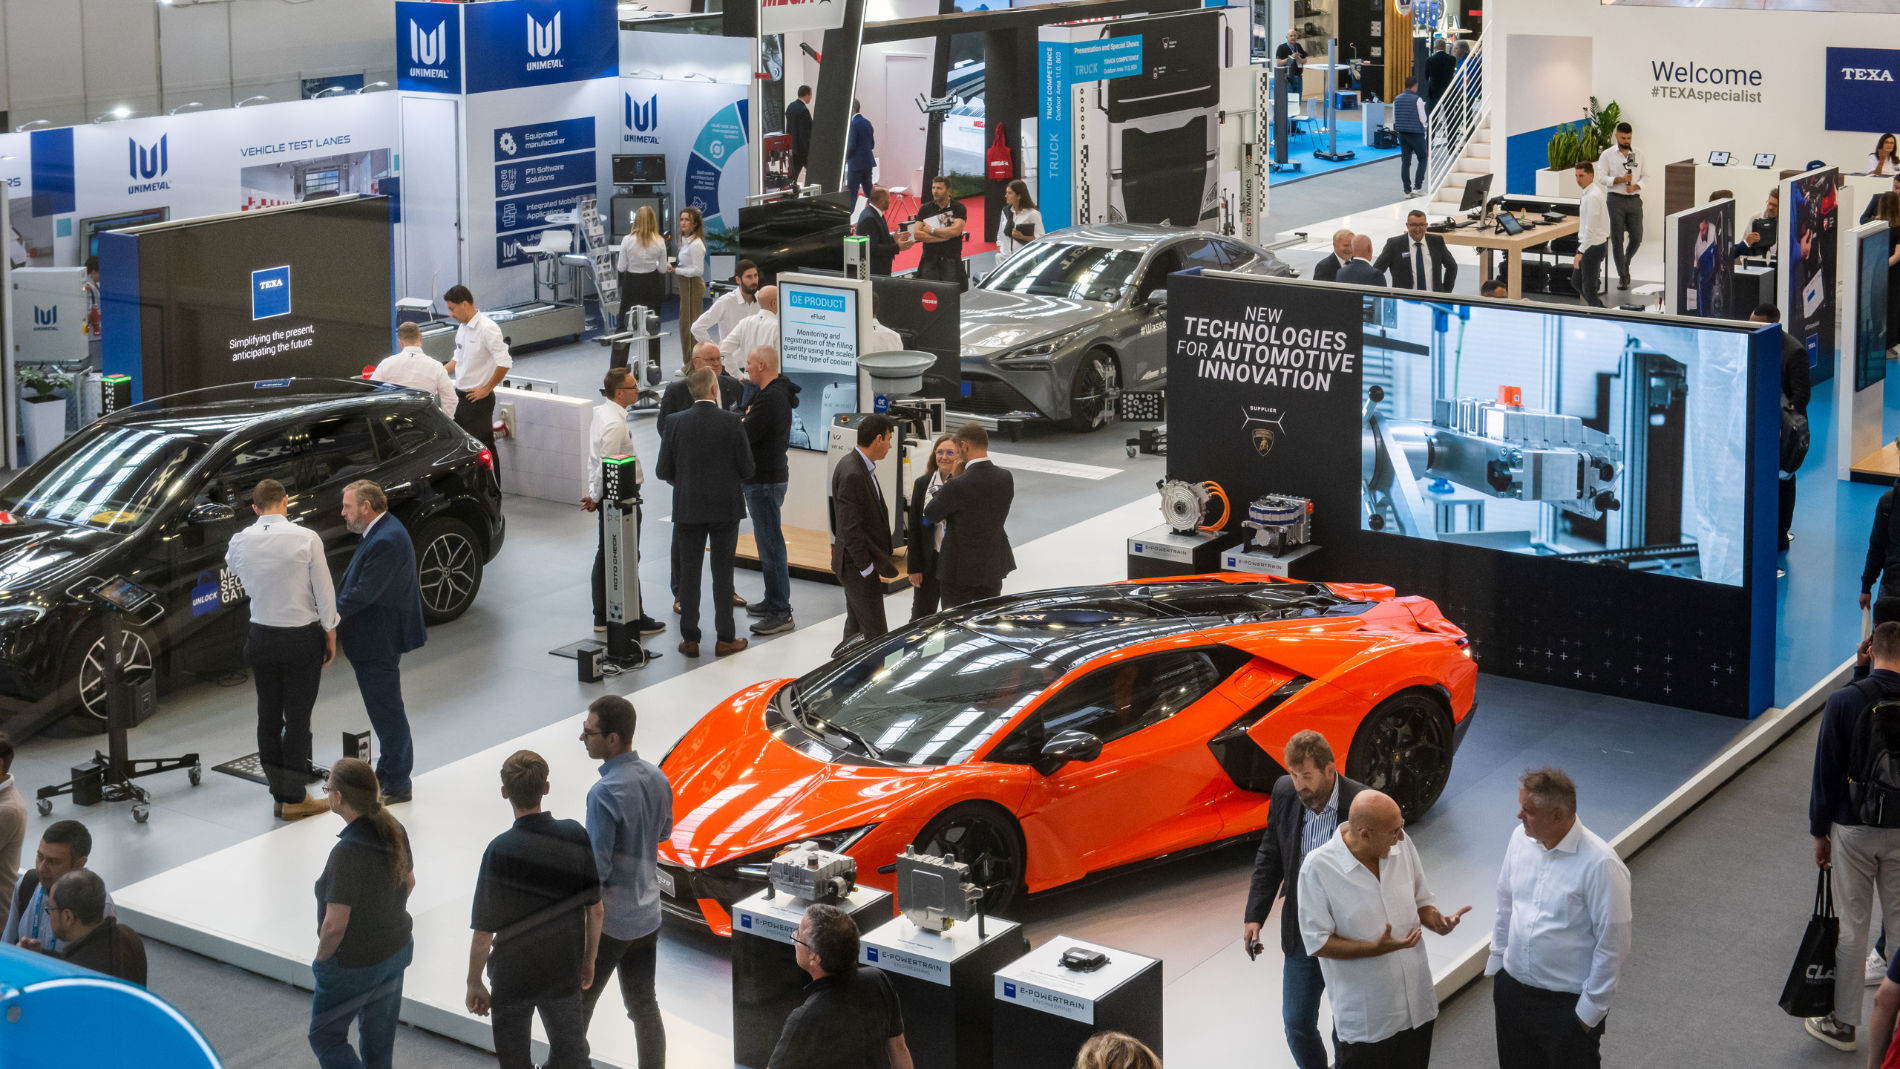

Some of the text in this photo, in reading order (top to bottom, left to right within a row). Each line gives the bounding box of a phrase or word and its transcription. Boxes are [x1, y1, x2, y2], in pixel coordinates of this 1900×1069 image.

[1074, 45, 1100, 54] Presentation
[527, 59, 563, 71] UNIMETAL
[1075, 63, 1098, 75] TRUCK
[410, 68, 448, 79] UNIMETAL
[1652, 60, 1762, 86] Welcome
[1841, 68, 1894, 82] TEXA
[1651, 86, 1762, 103] #TEXAspecialist
[525, 130, 558, 141] Equipment
[624, 135, 659, 144] UNIMETAL
[240, 135, 351, 157] VEHICLE TEST LANES
[525, 138, 565, 149] manufacturer
[1049, 133, 1059, 179] TRUCK
[526, 175, 554, 184] Solutions
[128, 182, 170, 194] UNIMETAL
[526, 200, 557, 211] Integrated
[259, 279, 283, 289] TEXA
[792, 295, 843, 308] OE PRODUCT
[1245, 306, 1283, 324] NEW
[229, 325, 314, 349] Simplifying the present,
[797, 329, 828, 339] Monitoring
[1184, 316, 1347, 350] TECHNOLOGIES
[233, 338, 312, 361] anticipating the future
[784, 345, 807, 353] quantity
[785, 336, 817, 345] registration
[837, 342, 853, 351] filling
[1177, 340, 1355, 373] FOR AUTOMOTIVE
[1198, 359, 1331, 392] INNOVATION
[193, 591, 217, 606] UNLOCK
[882, 952, 942, 972] E-POWERTRAIN
[1020, 988, 1084, 1010] E-POWERTRAIN
